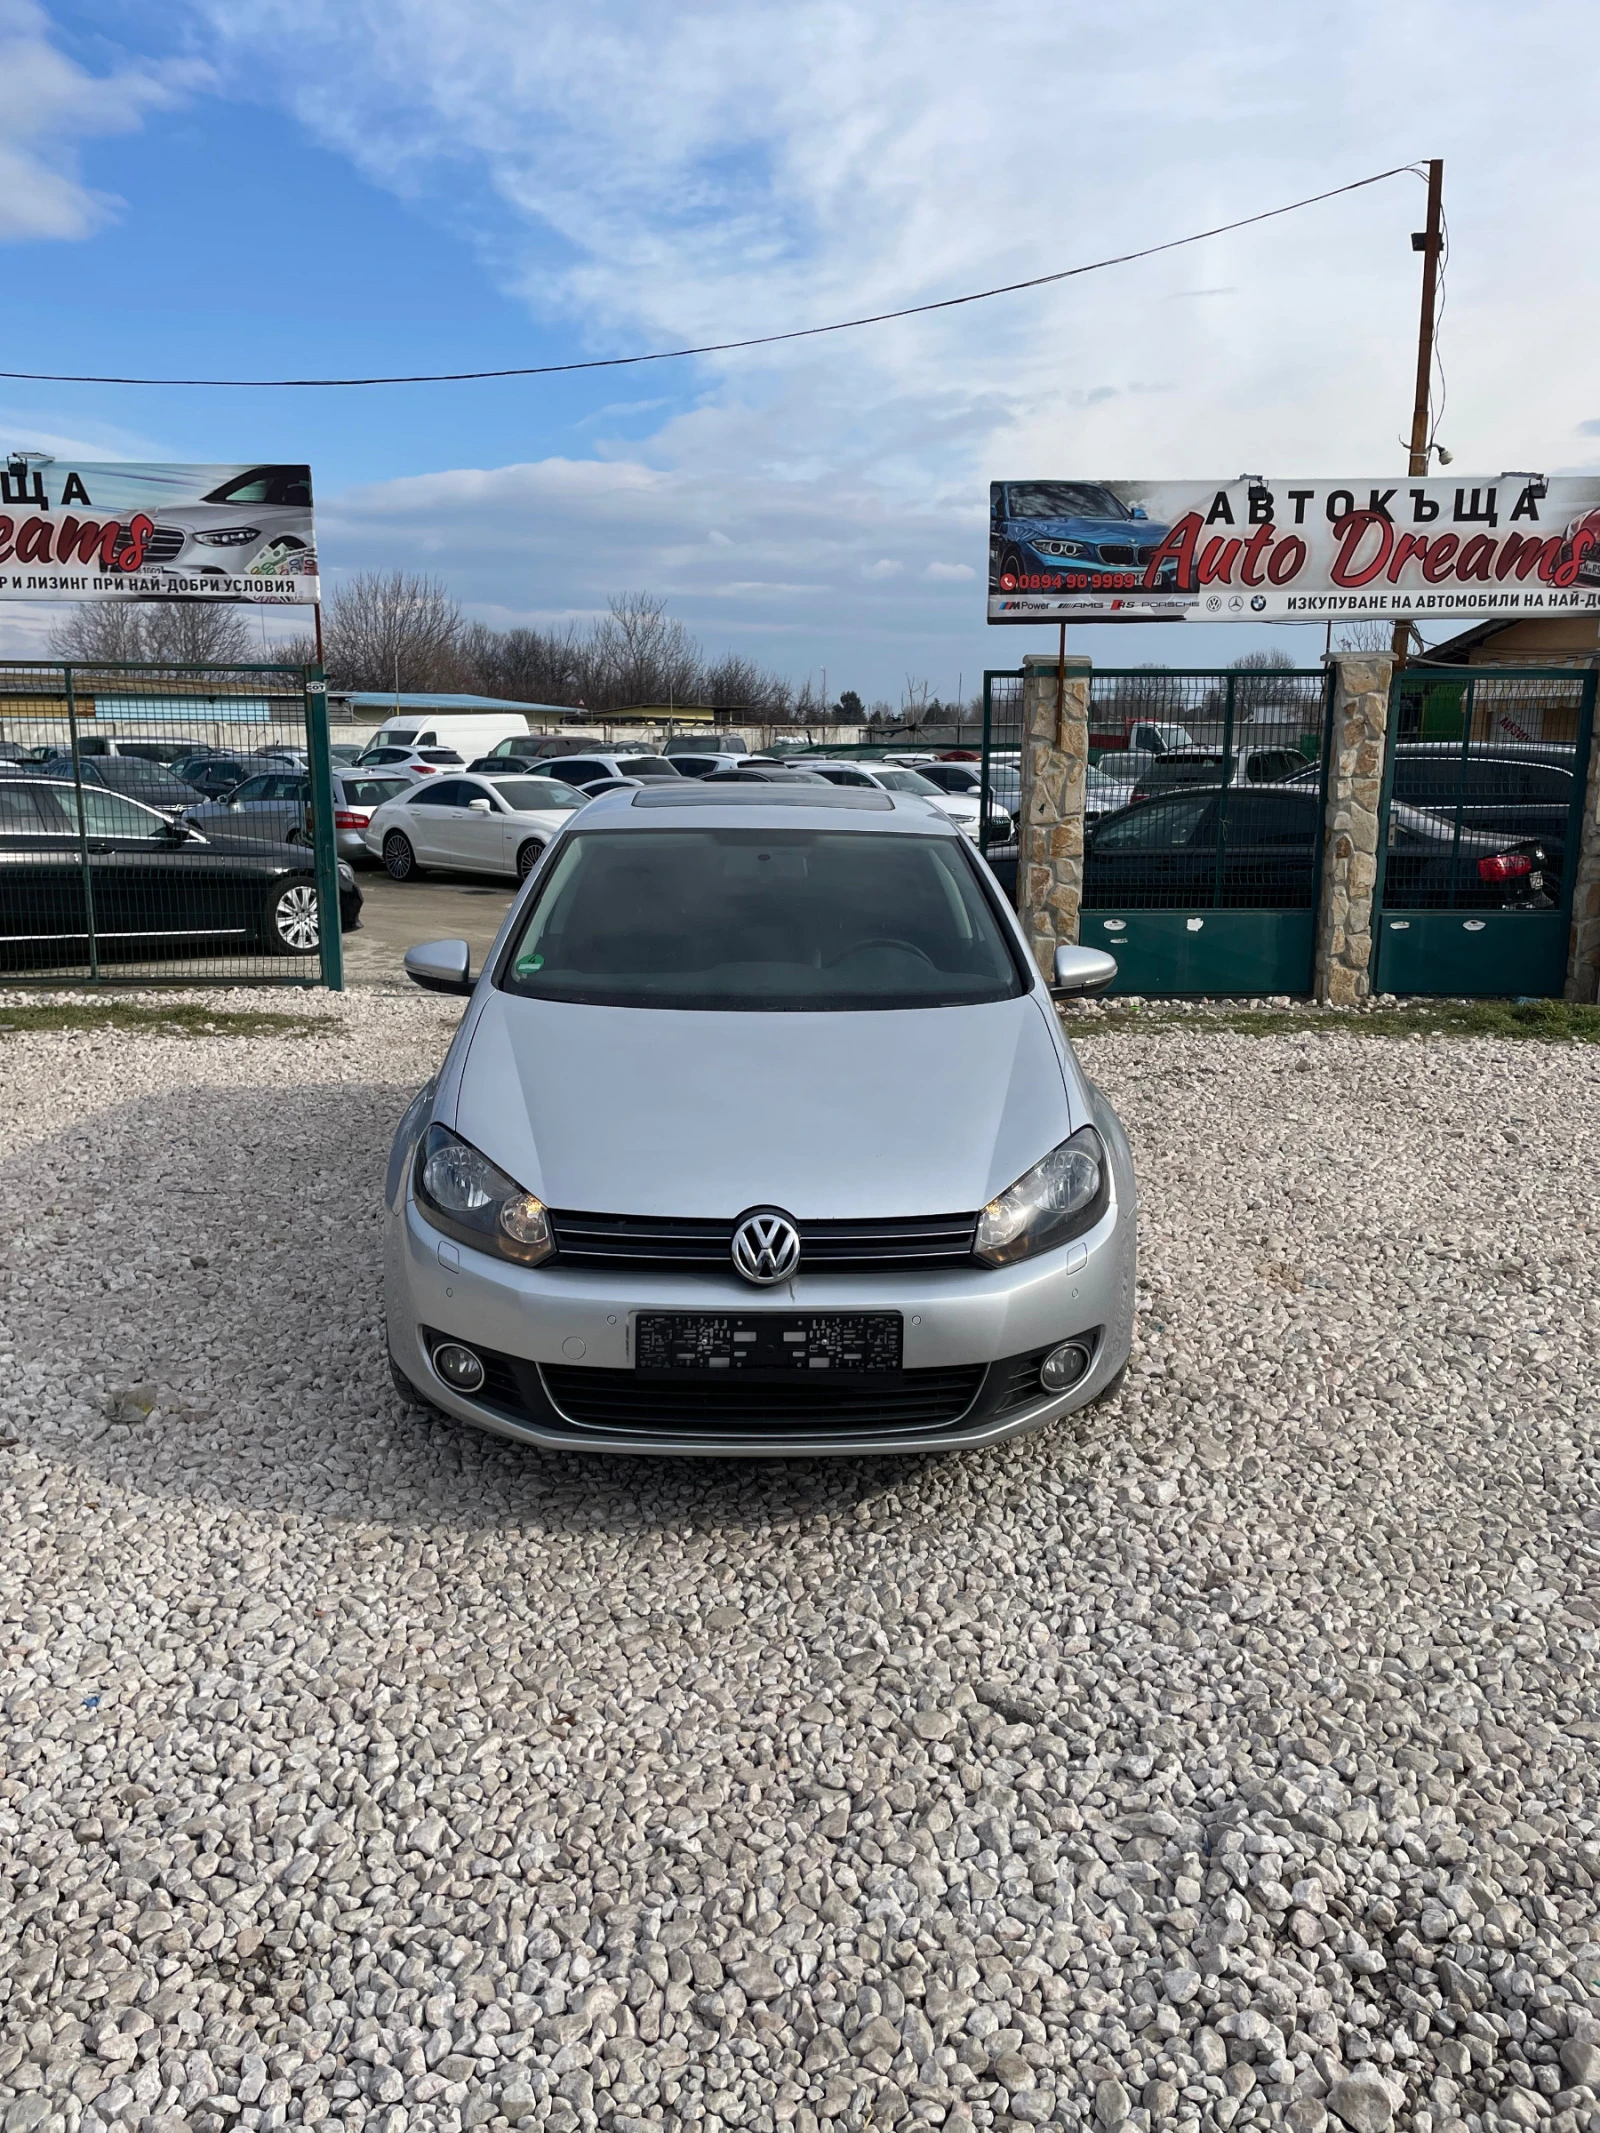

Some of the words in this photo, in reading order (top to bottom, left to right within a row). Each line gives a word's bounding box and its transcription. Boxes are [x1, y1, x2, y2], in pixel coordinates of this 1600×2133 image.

[1205, 488, 1541, 527] АВТОКЪЩА
[1142, 511, 1307, 590] Auto
[1330, 508, 1596, 589] Dreams
[12, 577, 22, 588] И
[26, 577, 88, 590] ЛИЗИНГ
[93, 578, 124, 591] ПРИ
[129, 576, 219, 593] НАЙ-ДОБРИ
[224, 580, 295, 593] УСЛОВИЯ
[1019, 573, 1062, 589] 0894
[1066, 573, 1088, 589] 90
[1091, 573, 1136, 589] 9999
[1021, 602, 1049, 610] Power
[1287, 597, 1387, 610] ИЗКУПУВАНЕ
[1392, 597, 1411, 609] НА
[1416, 595, 1519, 608] АВТОМОБИЛИ
[1524, 595, 1544, 607] НА
